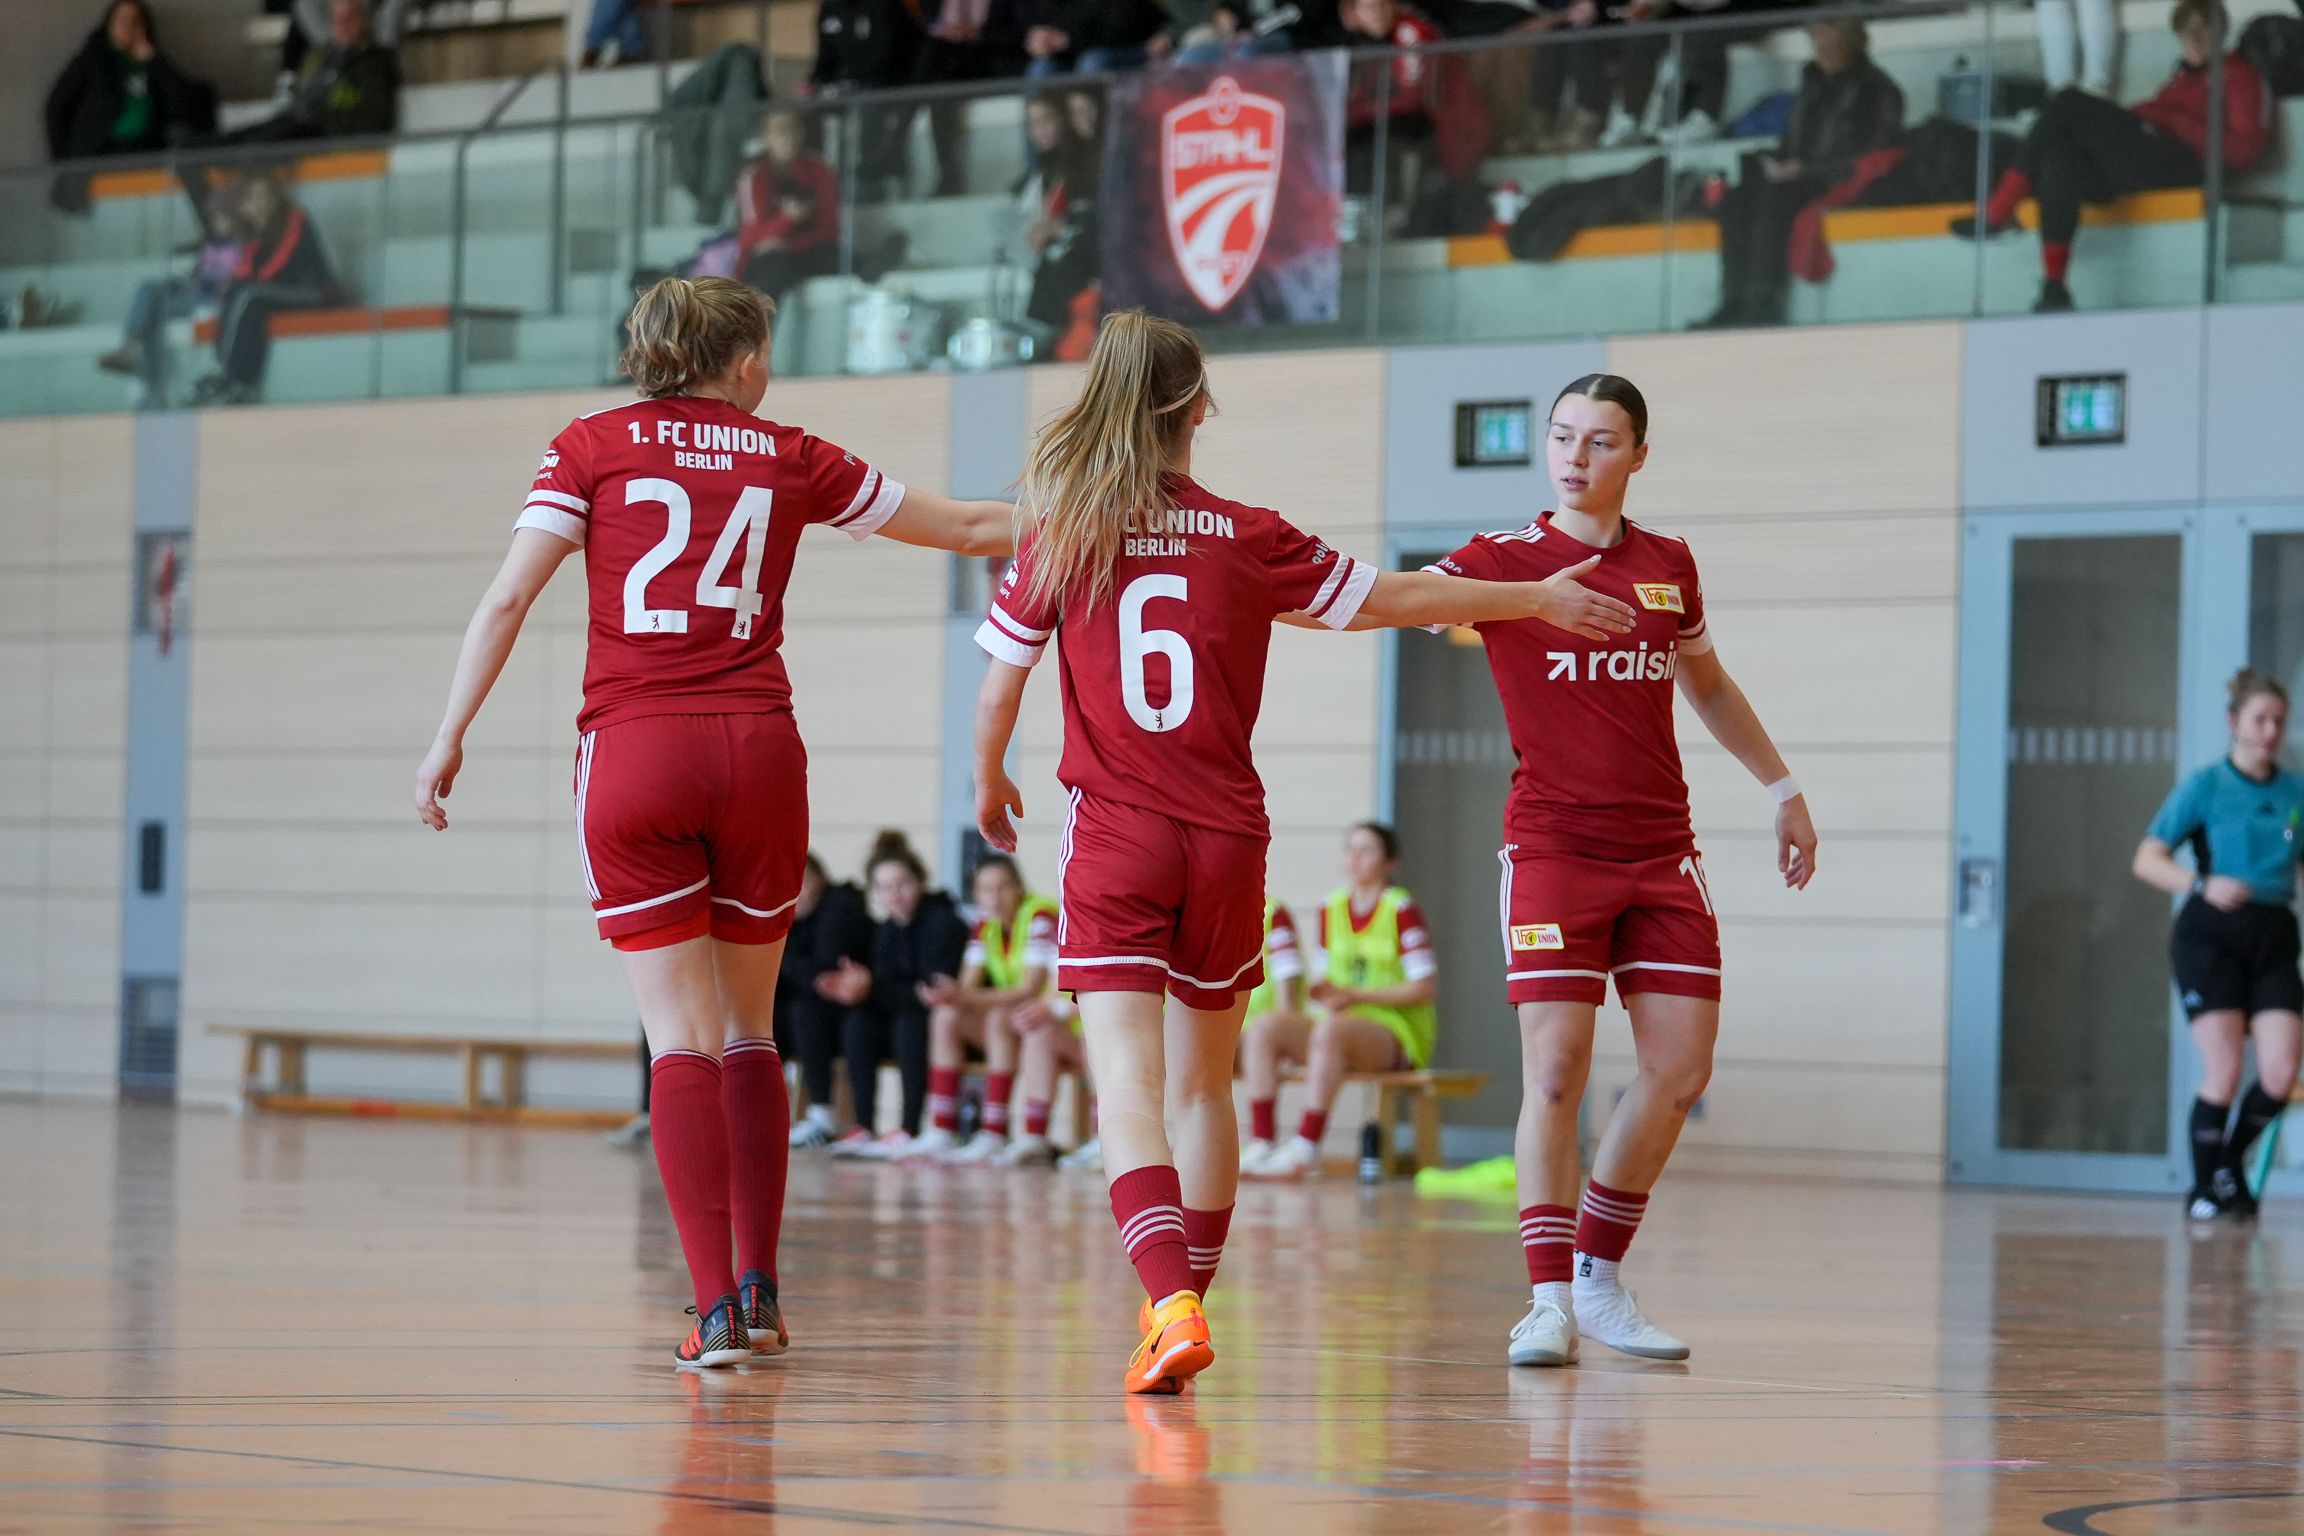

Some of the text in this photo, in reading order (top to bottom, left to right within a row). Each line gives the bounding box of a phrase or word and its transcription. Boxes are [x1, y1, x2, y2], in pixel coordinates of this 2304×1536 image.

[1174, 127, 1276, 170] STAHL
[628, 420, 777, 457] 1. FC UNION
[675, 451, 733, 471] BERLIN
[1146, 509, 1235, 539] UNION
[623, 477, 773, 641] 24
[1125, 538, 1187, 557] BERLIN
[1118, 573, 1194, 733] 6
